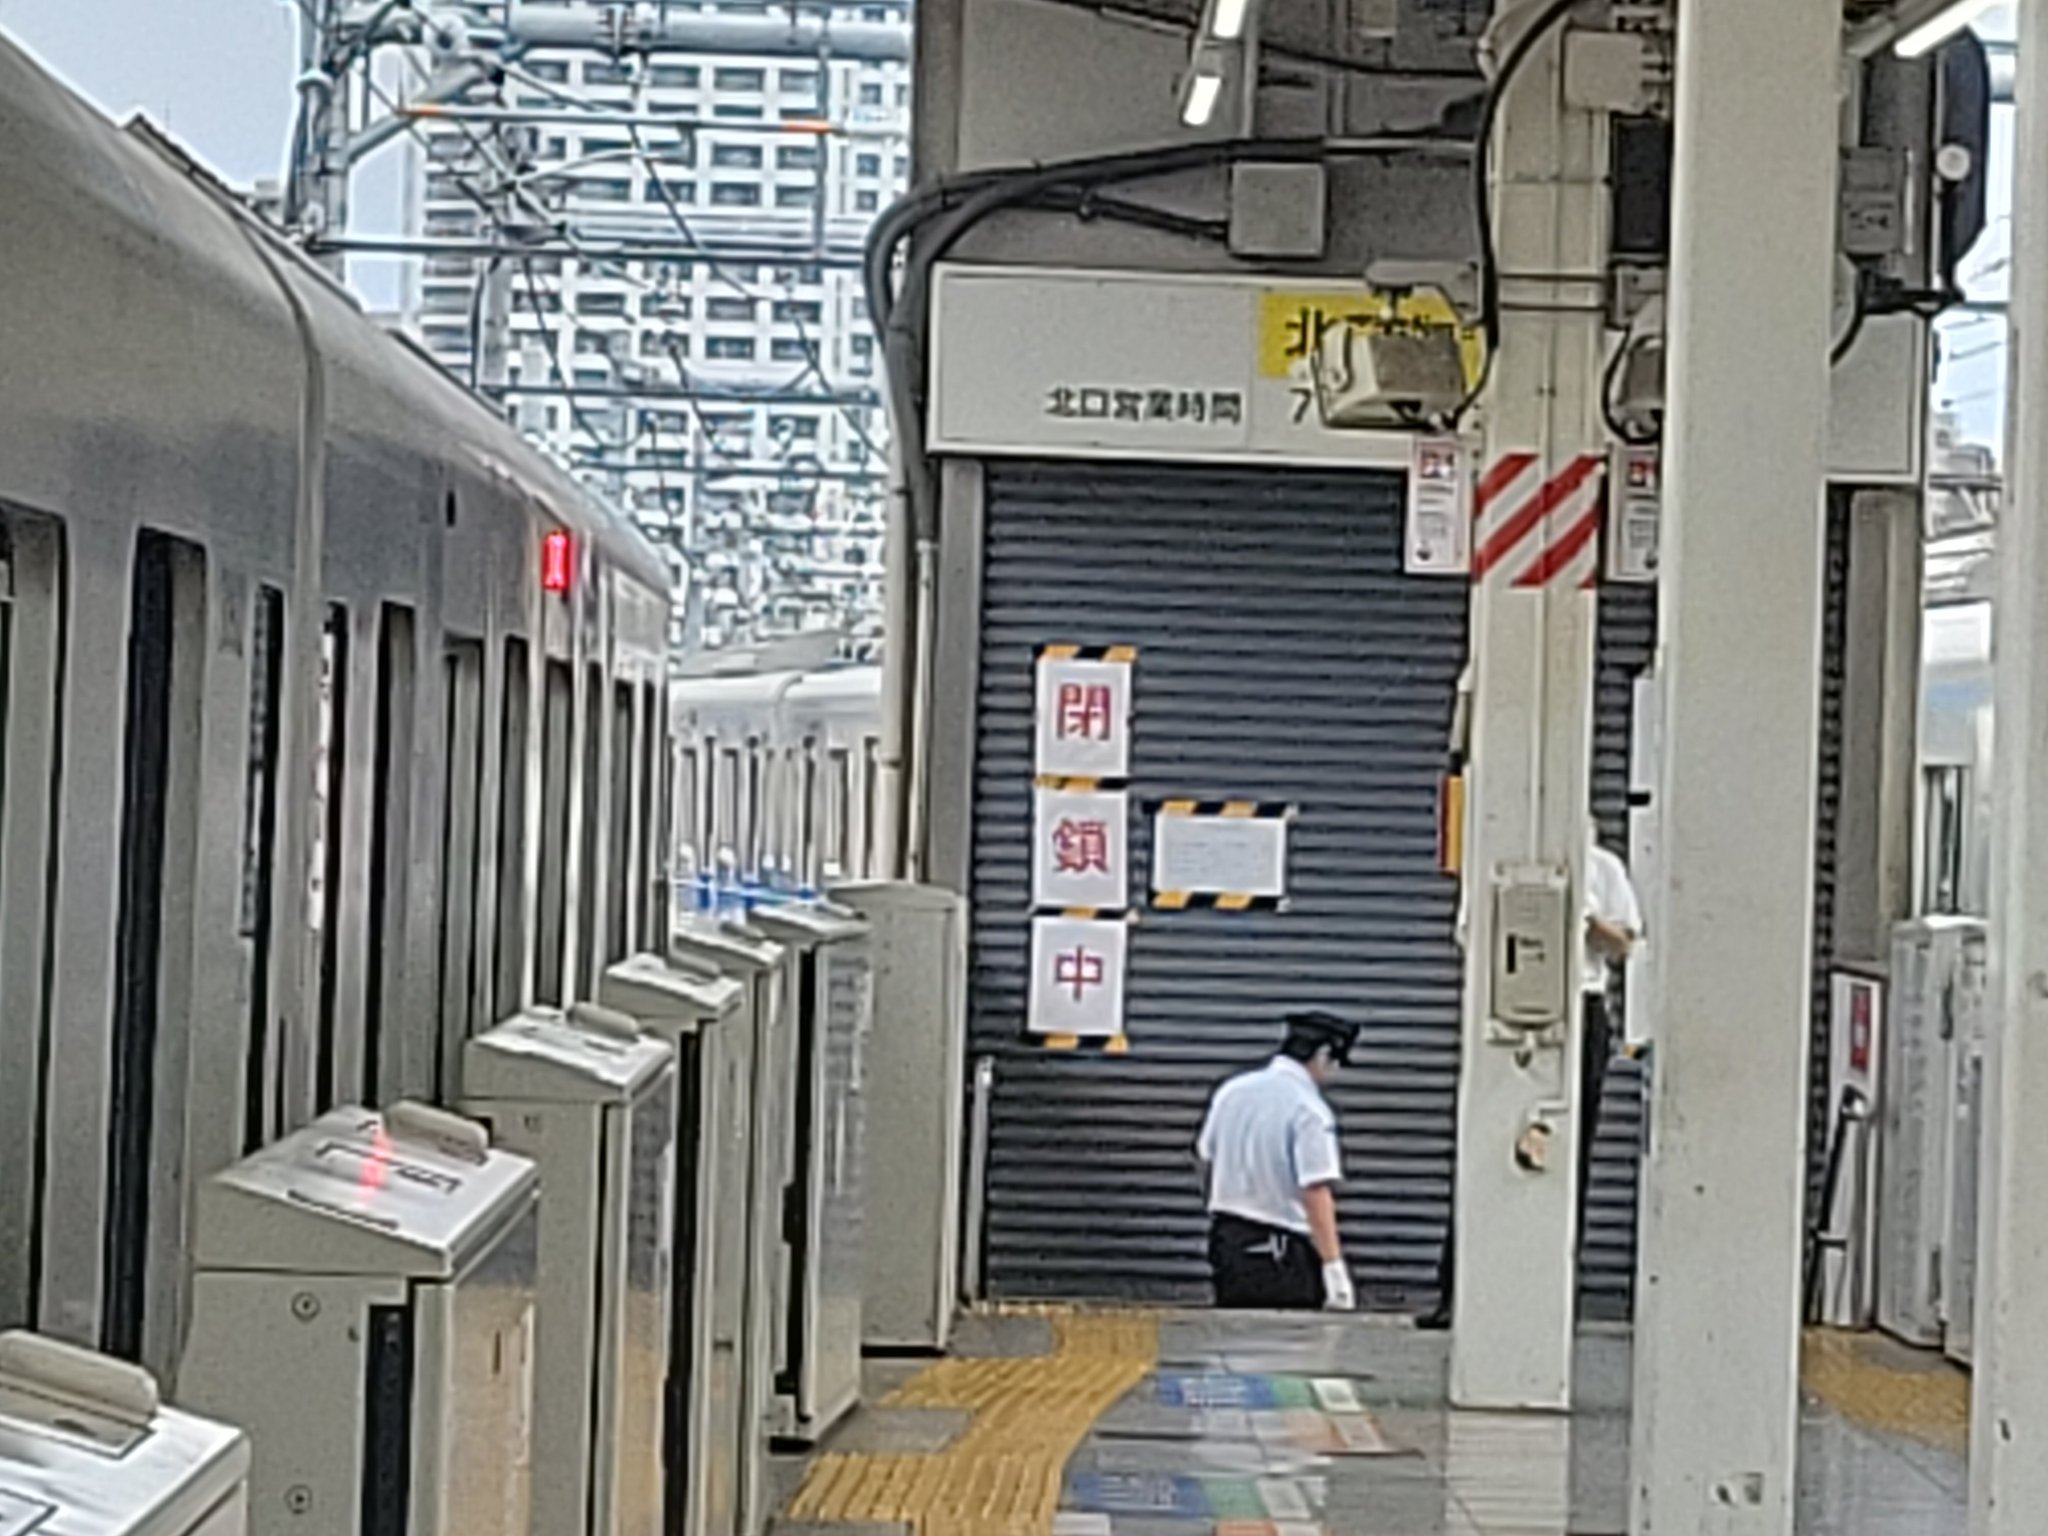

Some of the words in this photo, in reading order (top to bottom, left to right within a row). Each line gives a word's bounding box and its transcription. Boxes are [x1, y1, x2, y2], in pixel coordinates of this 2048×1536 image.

[1045, 386, 1242, 425] 北口営業時間
